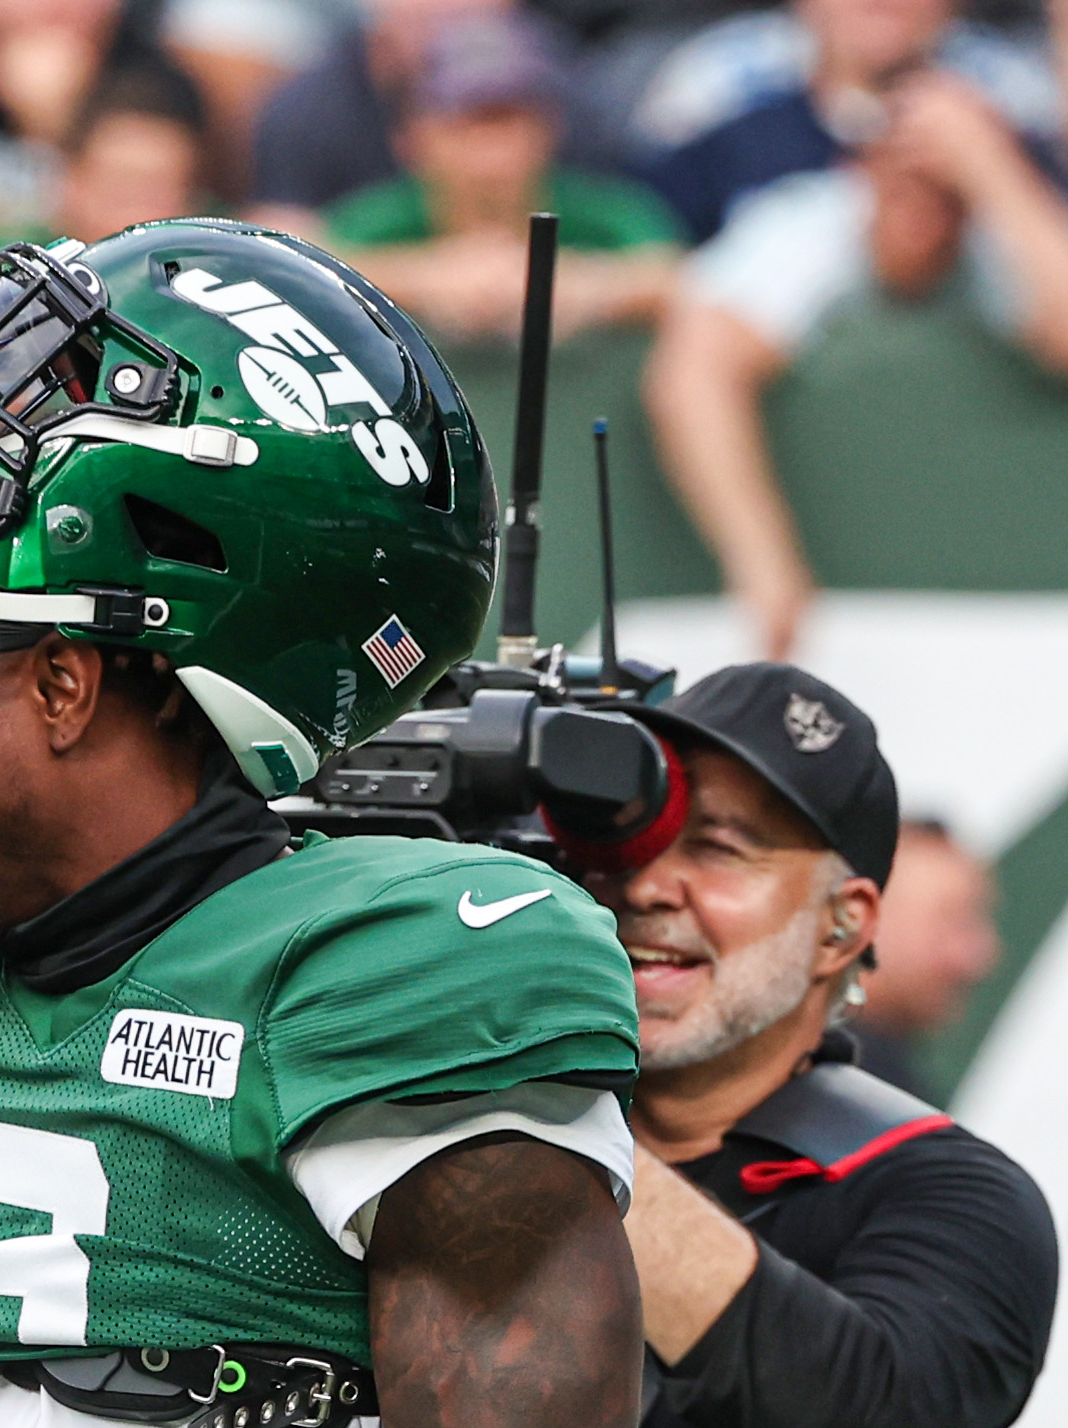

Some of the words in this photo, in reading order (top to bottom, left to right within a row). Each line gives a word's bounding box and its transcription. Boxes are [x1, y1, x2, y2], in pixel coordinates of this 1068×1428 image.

[172, 267, 432, 487] JETS
[110, 1017, 236, 1062] ATLANTIC
[120, 1047, 216, 1089] HEALTH
